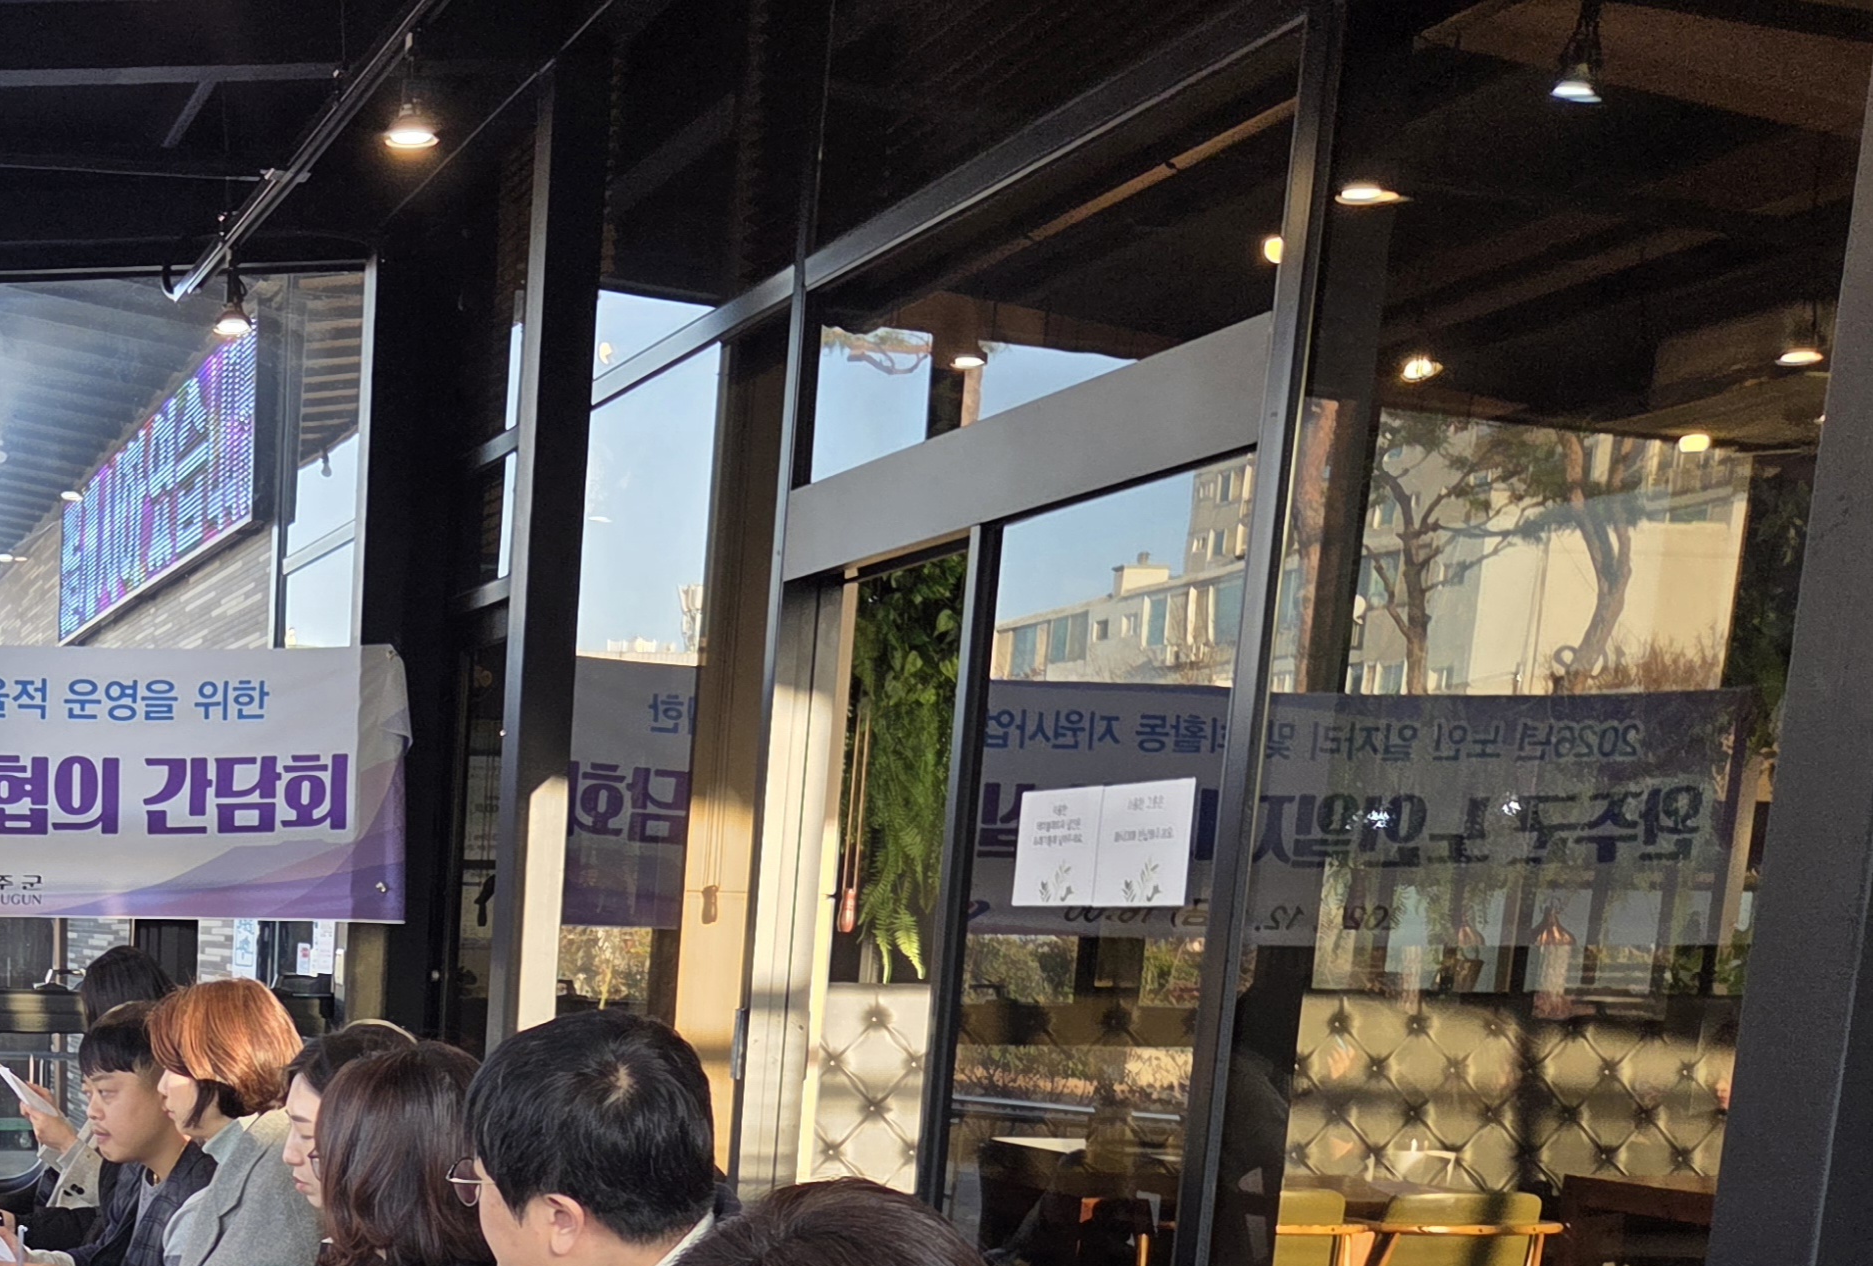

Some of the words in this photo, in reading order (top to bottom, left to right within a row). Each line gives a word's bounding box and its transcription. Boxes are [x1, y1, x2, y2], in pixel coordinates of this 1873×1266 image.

[63, 679, 179, 722] 운영을
[194, 680, 270, 722] 위한
[143, 753, 348, 834] 간담회
